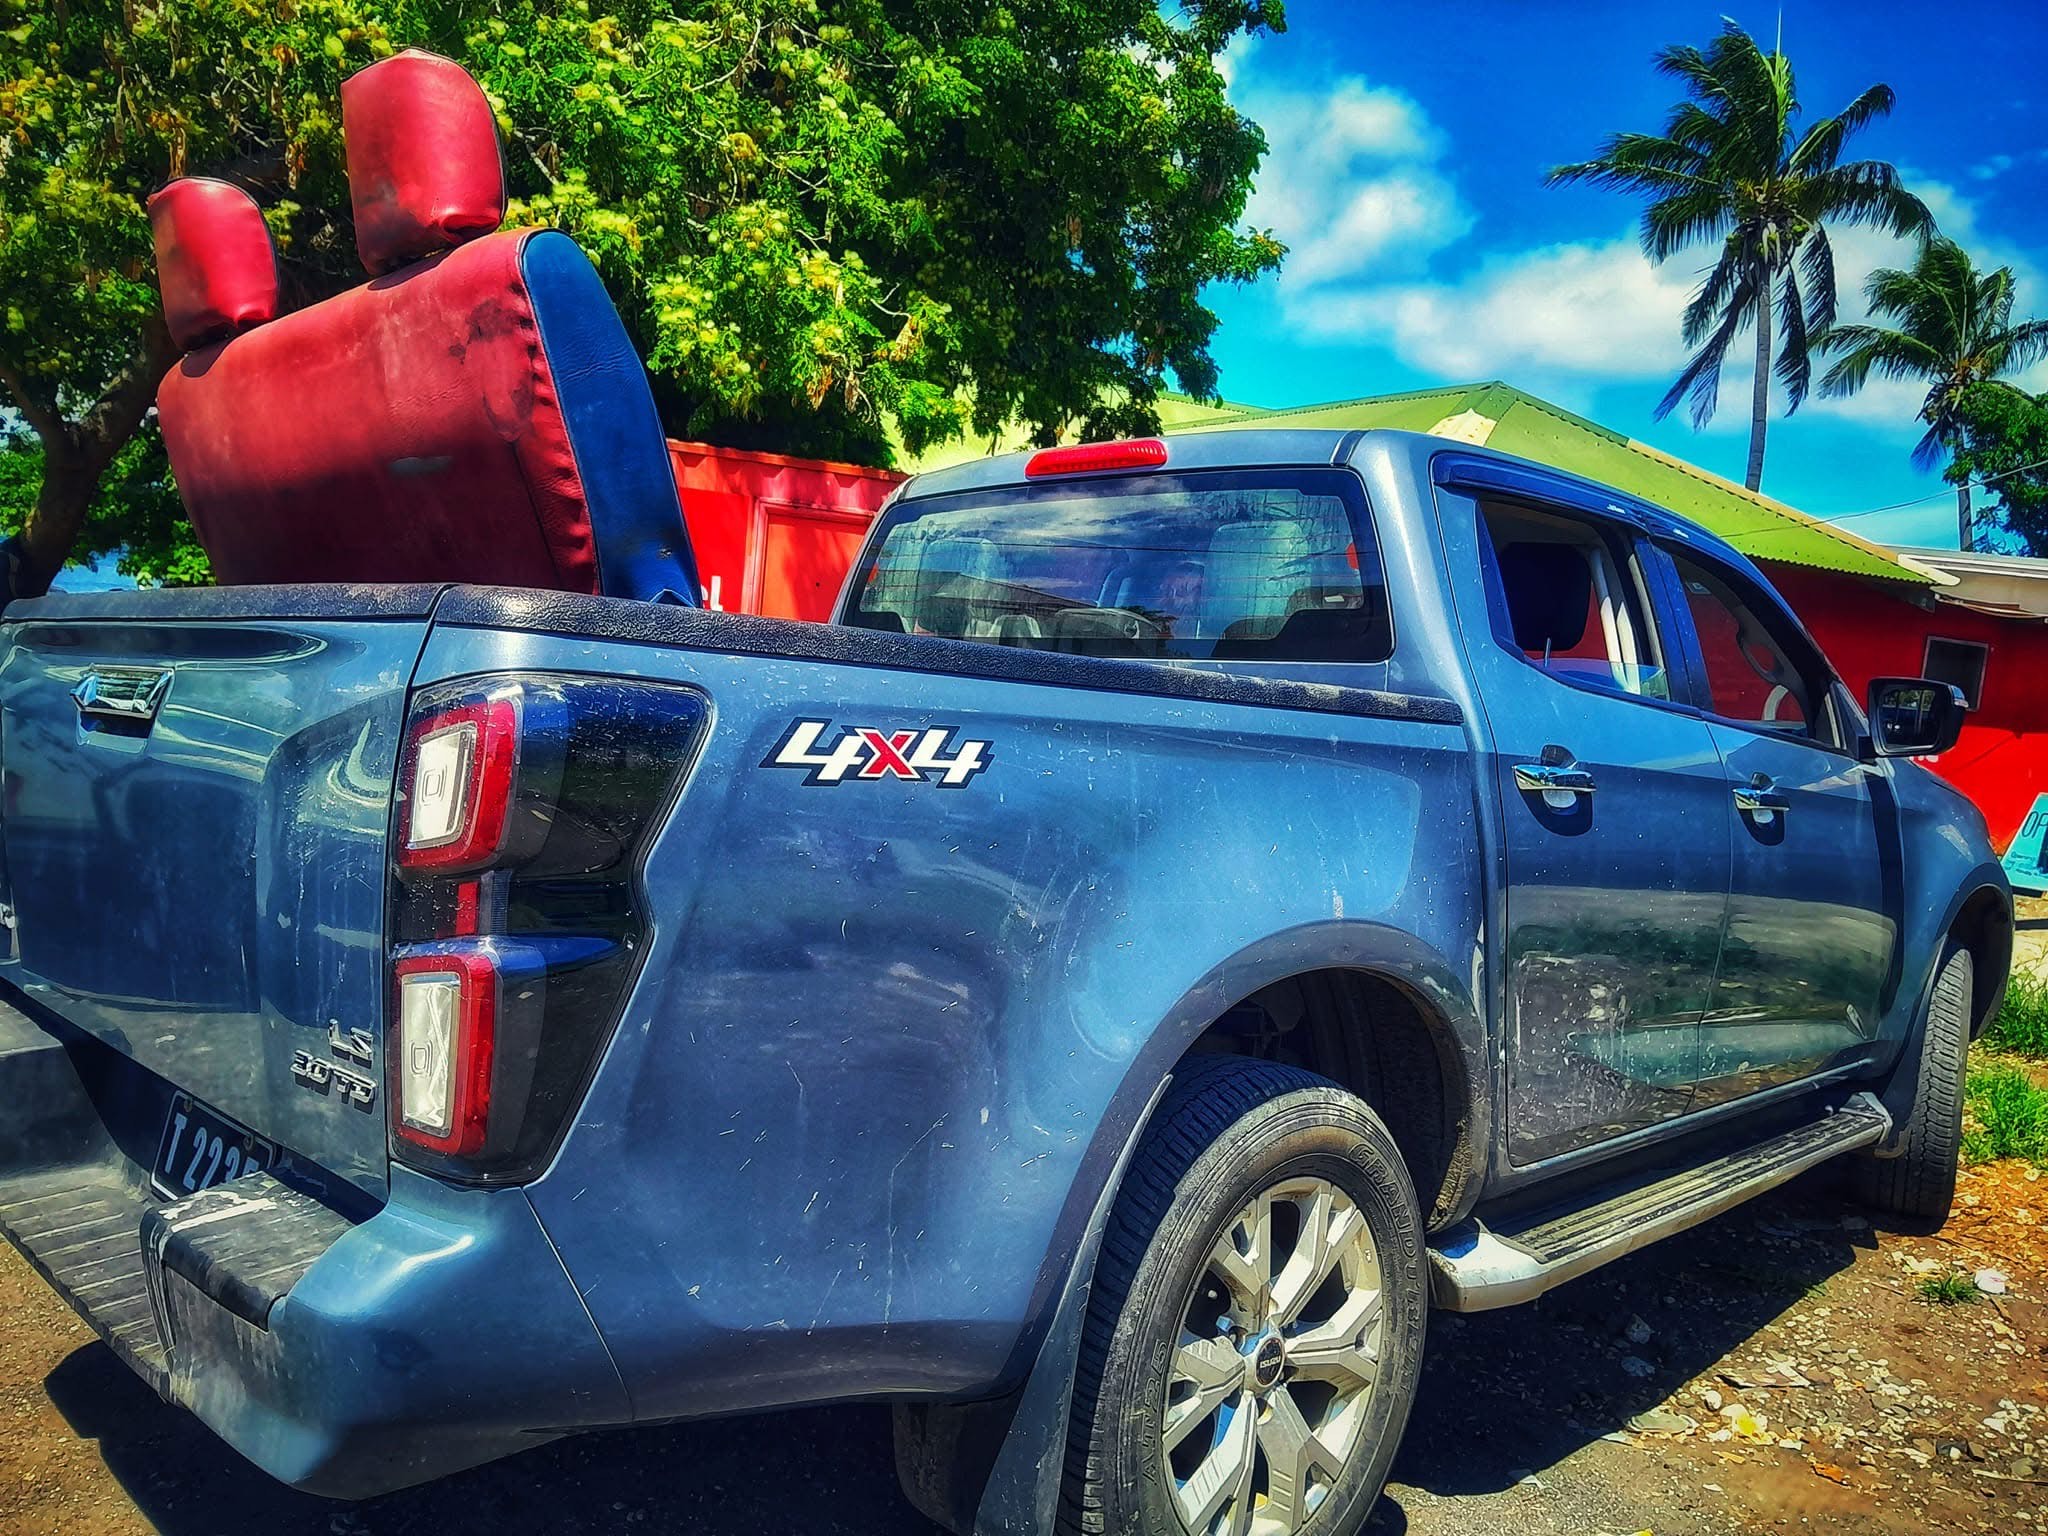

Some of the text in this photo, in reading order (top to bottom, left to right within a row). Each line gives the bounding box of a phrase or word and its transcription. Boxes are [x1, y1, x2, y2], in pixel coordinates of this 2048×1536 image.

[328, 1018, 374, 1061] LS
[165, 1113, 260, 1191] T 223
